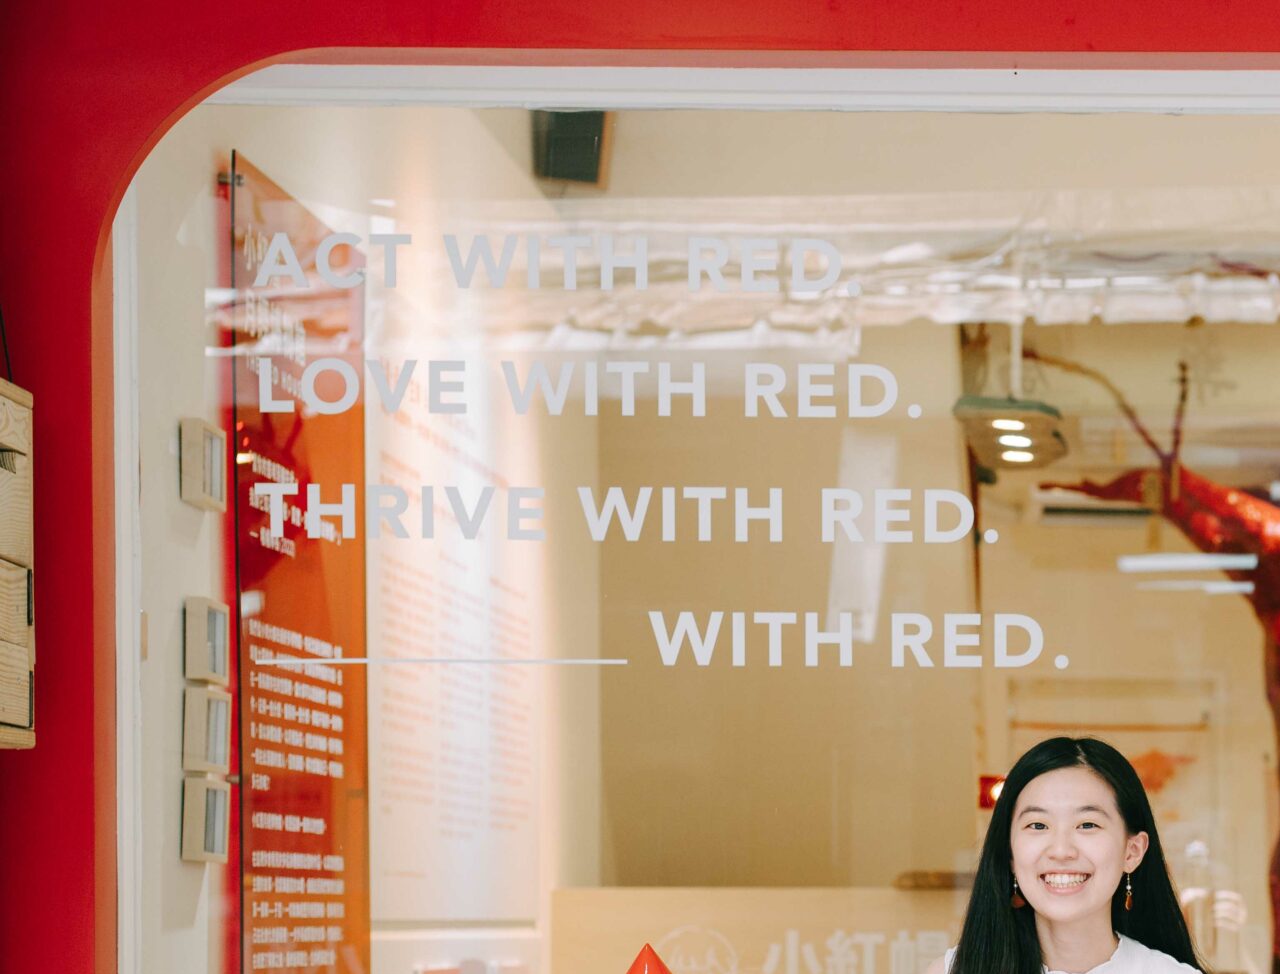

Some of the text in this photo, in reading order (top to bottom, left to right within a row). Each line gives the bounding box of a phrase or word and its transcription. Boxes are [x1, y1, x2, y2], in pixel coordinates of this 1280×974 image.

[254, 232, 412, 289] ACT
[443, 234, 649, 291] WITH
[688, 237, 861, 297] RED.
[258, 357, 468, 415] LOVE
[501, 360, 706, 417] WITH
[744, 362, 923, 419] RED.
[254, 482, 546, 542] THRIVE
[577, 486, 783, 542] WITH
[820, 488, 999, 544] RED.
[648, 610, 1070, 670] WITH RED.
